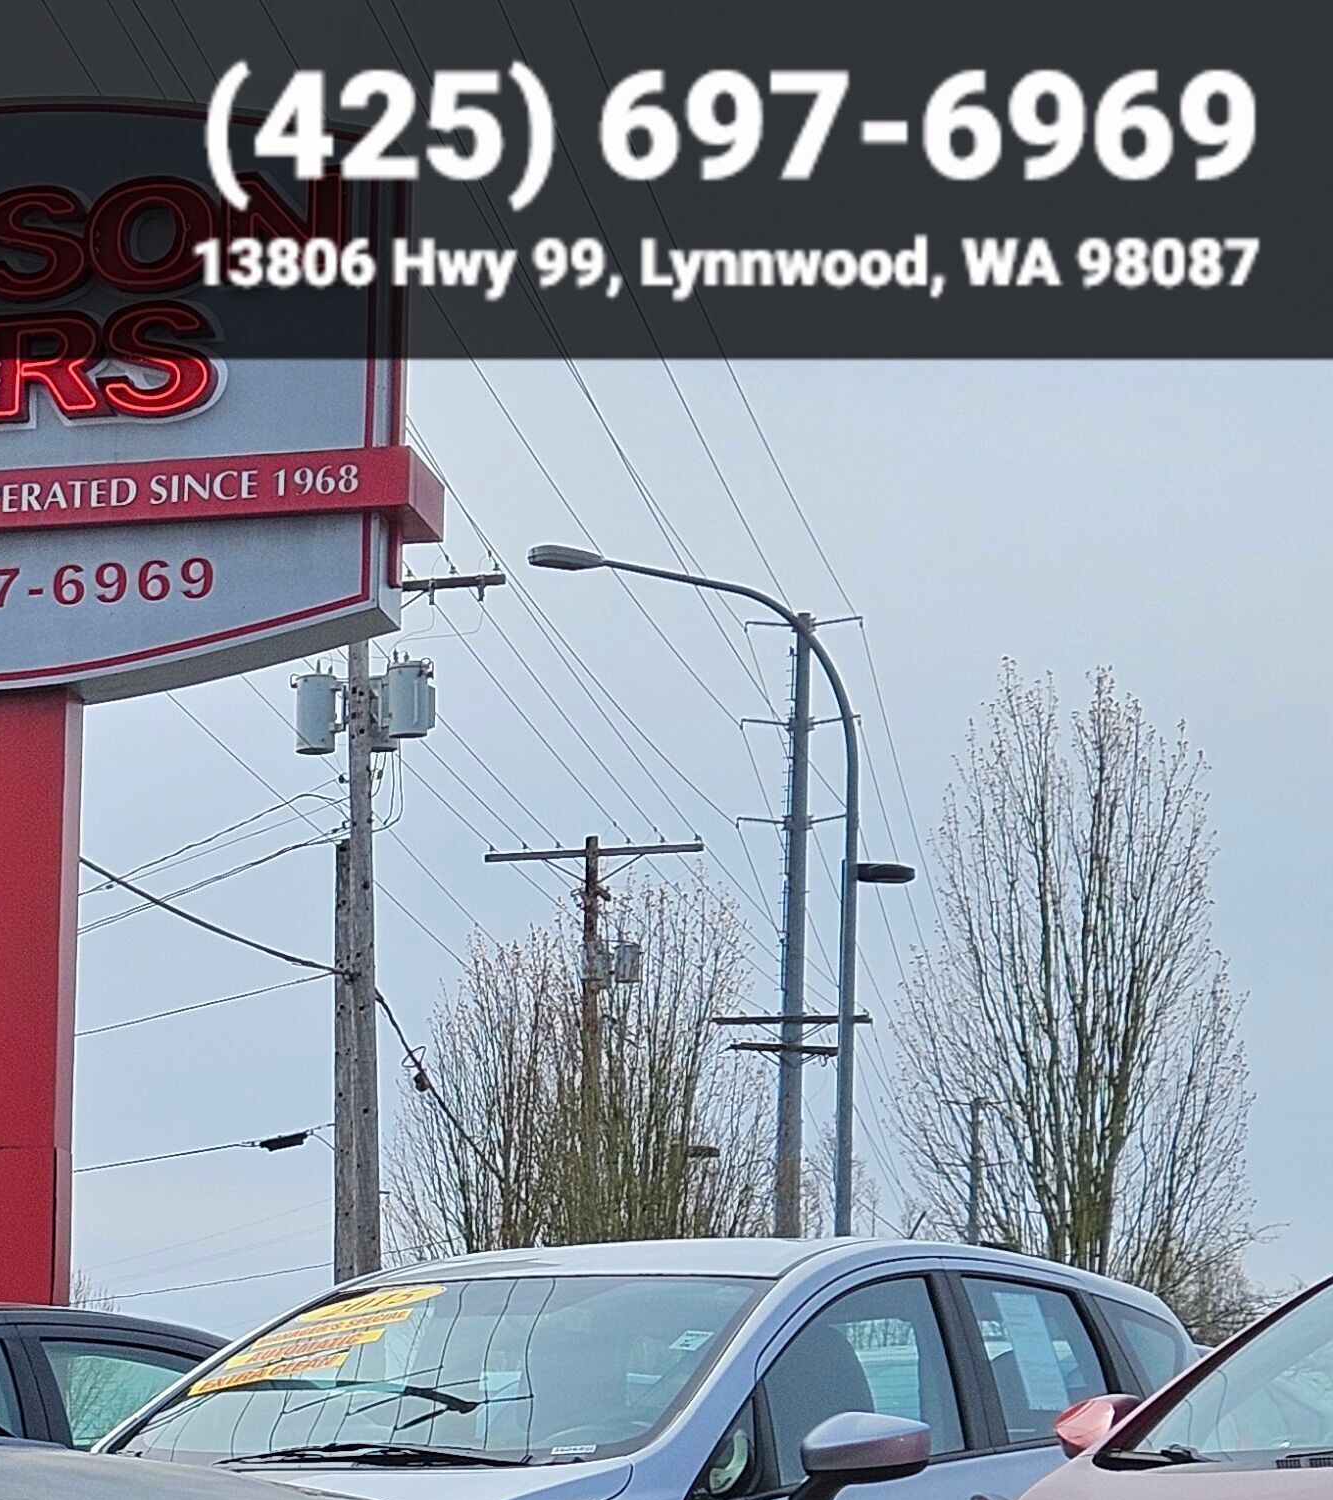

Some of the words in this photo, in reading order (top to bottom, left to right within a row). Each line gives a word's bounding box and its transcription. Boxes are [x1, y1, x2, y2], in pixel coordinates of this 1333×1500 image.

[149, 469, 259, 505] SINCE
[272, 463, 360, 497] 1968
[345, 1310, 408, 1329] SPECIAL
[245, 1332, 363, 1364] AUTOMATIC
[198, 1367, 268, 1391] EXTRA
[268, 1354, 339, 1377] CLEAN
